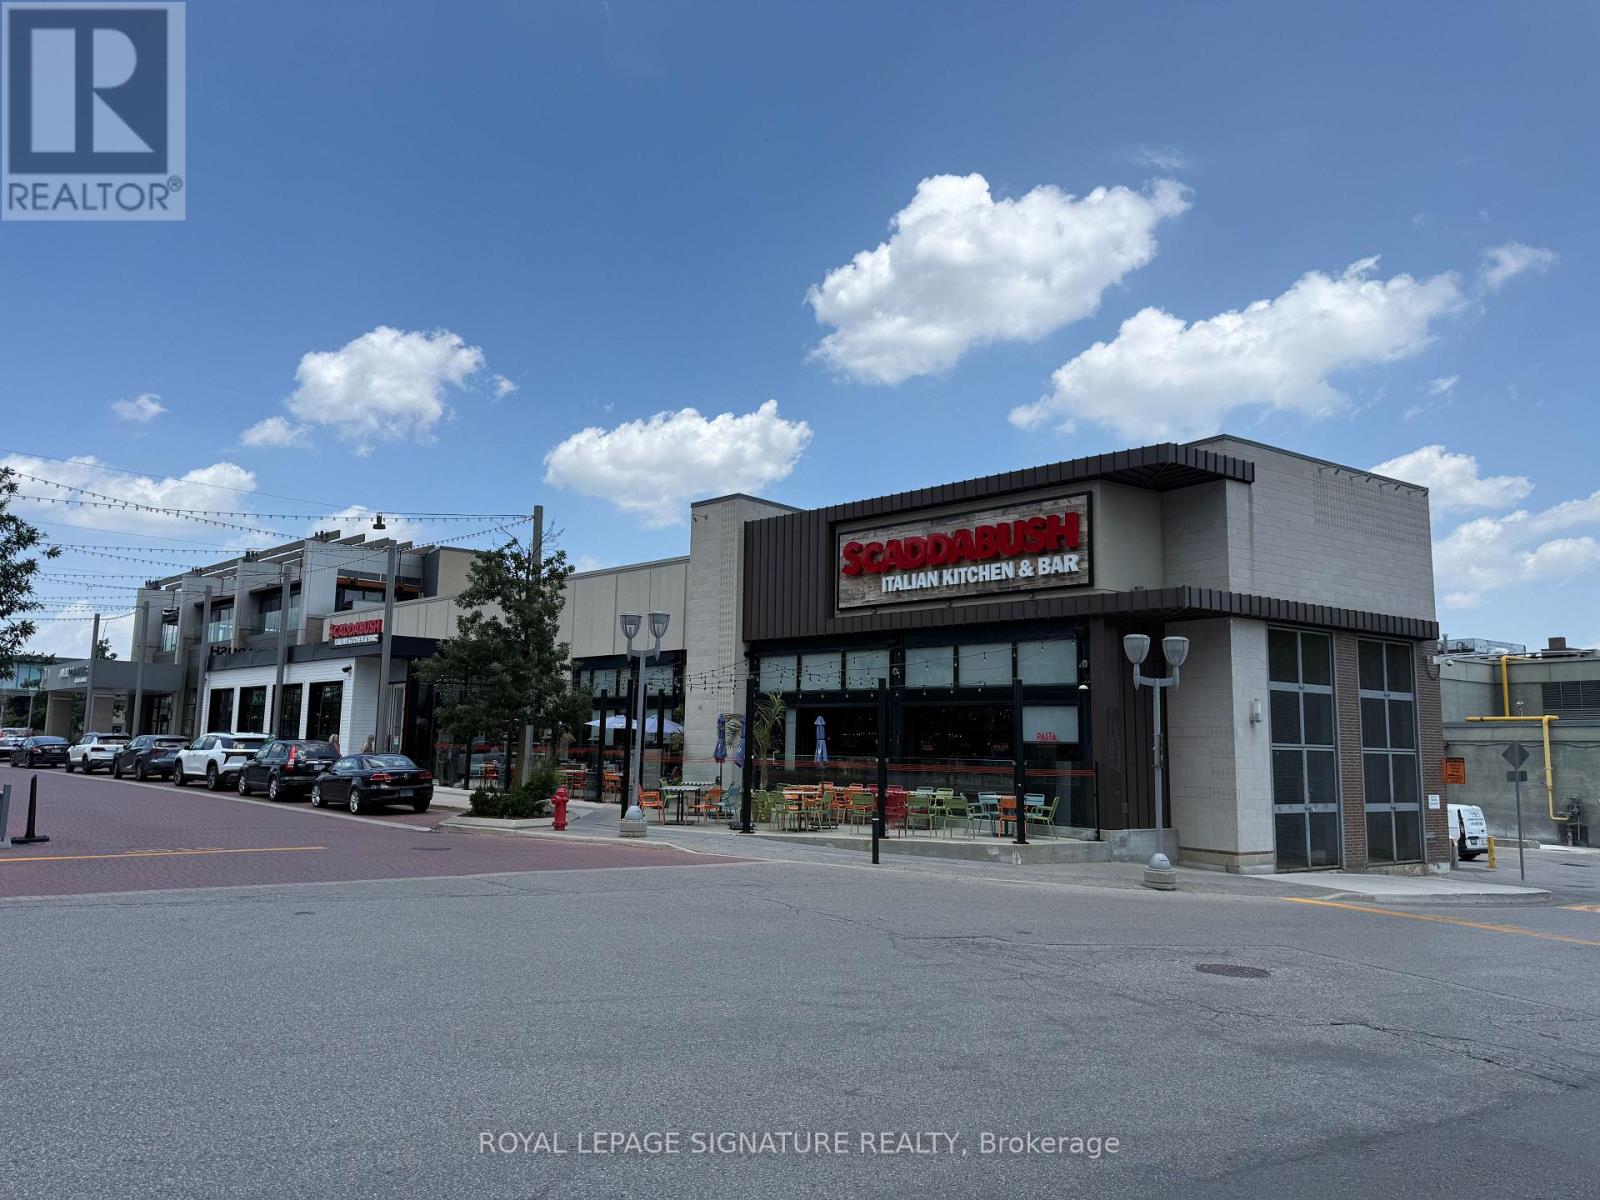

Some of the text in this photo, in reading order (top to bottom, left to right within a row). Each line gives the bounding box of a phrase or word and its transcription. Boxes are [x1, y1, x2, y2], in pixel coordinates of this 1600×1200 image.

[841, 511, 1080, 577] SCADDABUSH
[881, 554, 1080, 593] ITALIAN KITCHEN & BAR
